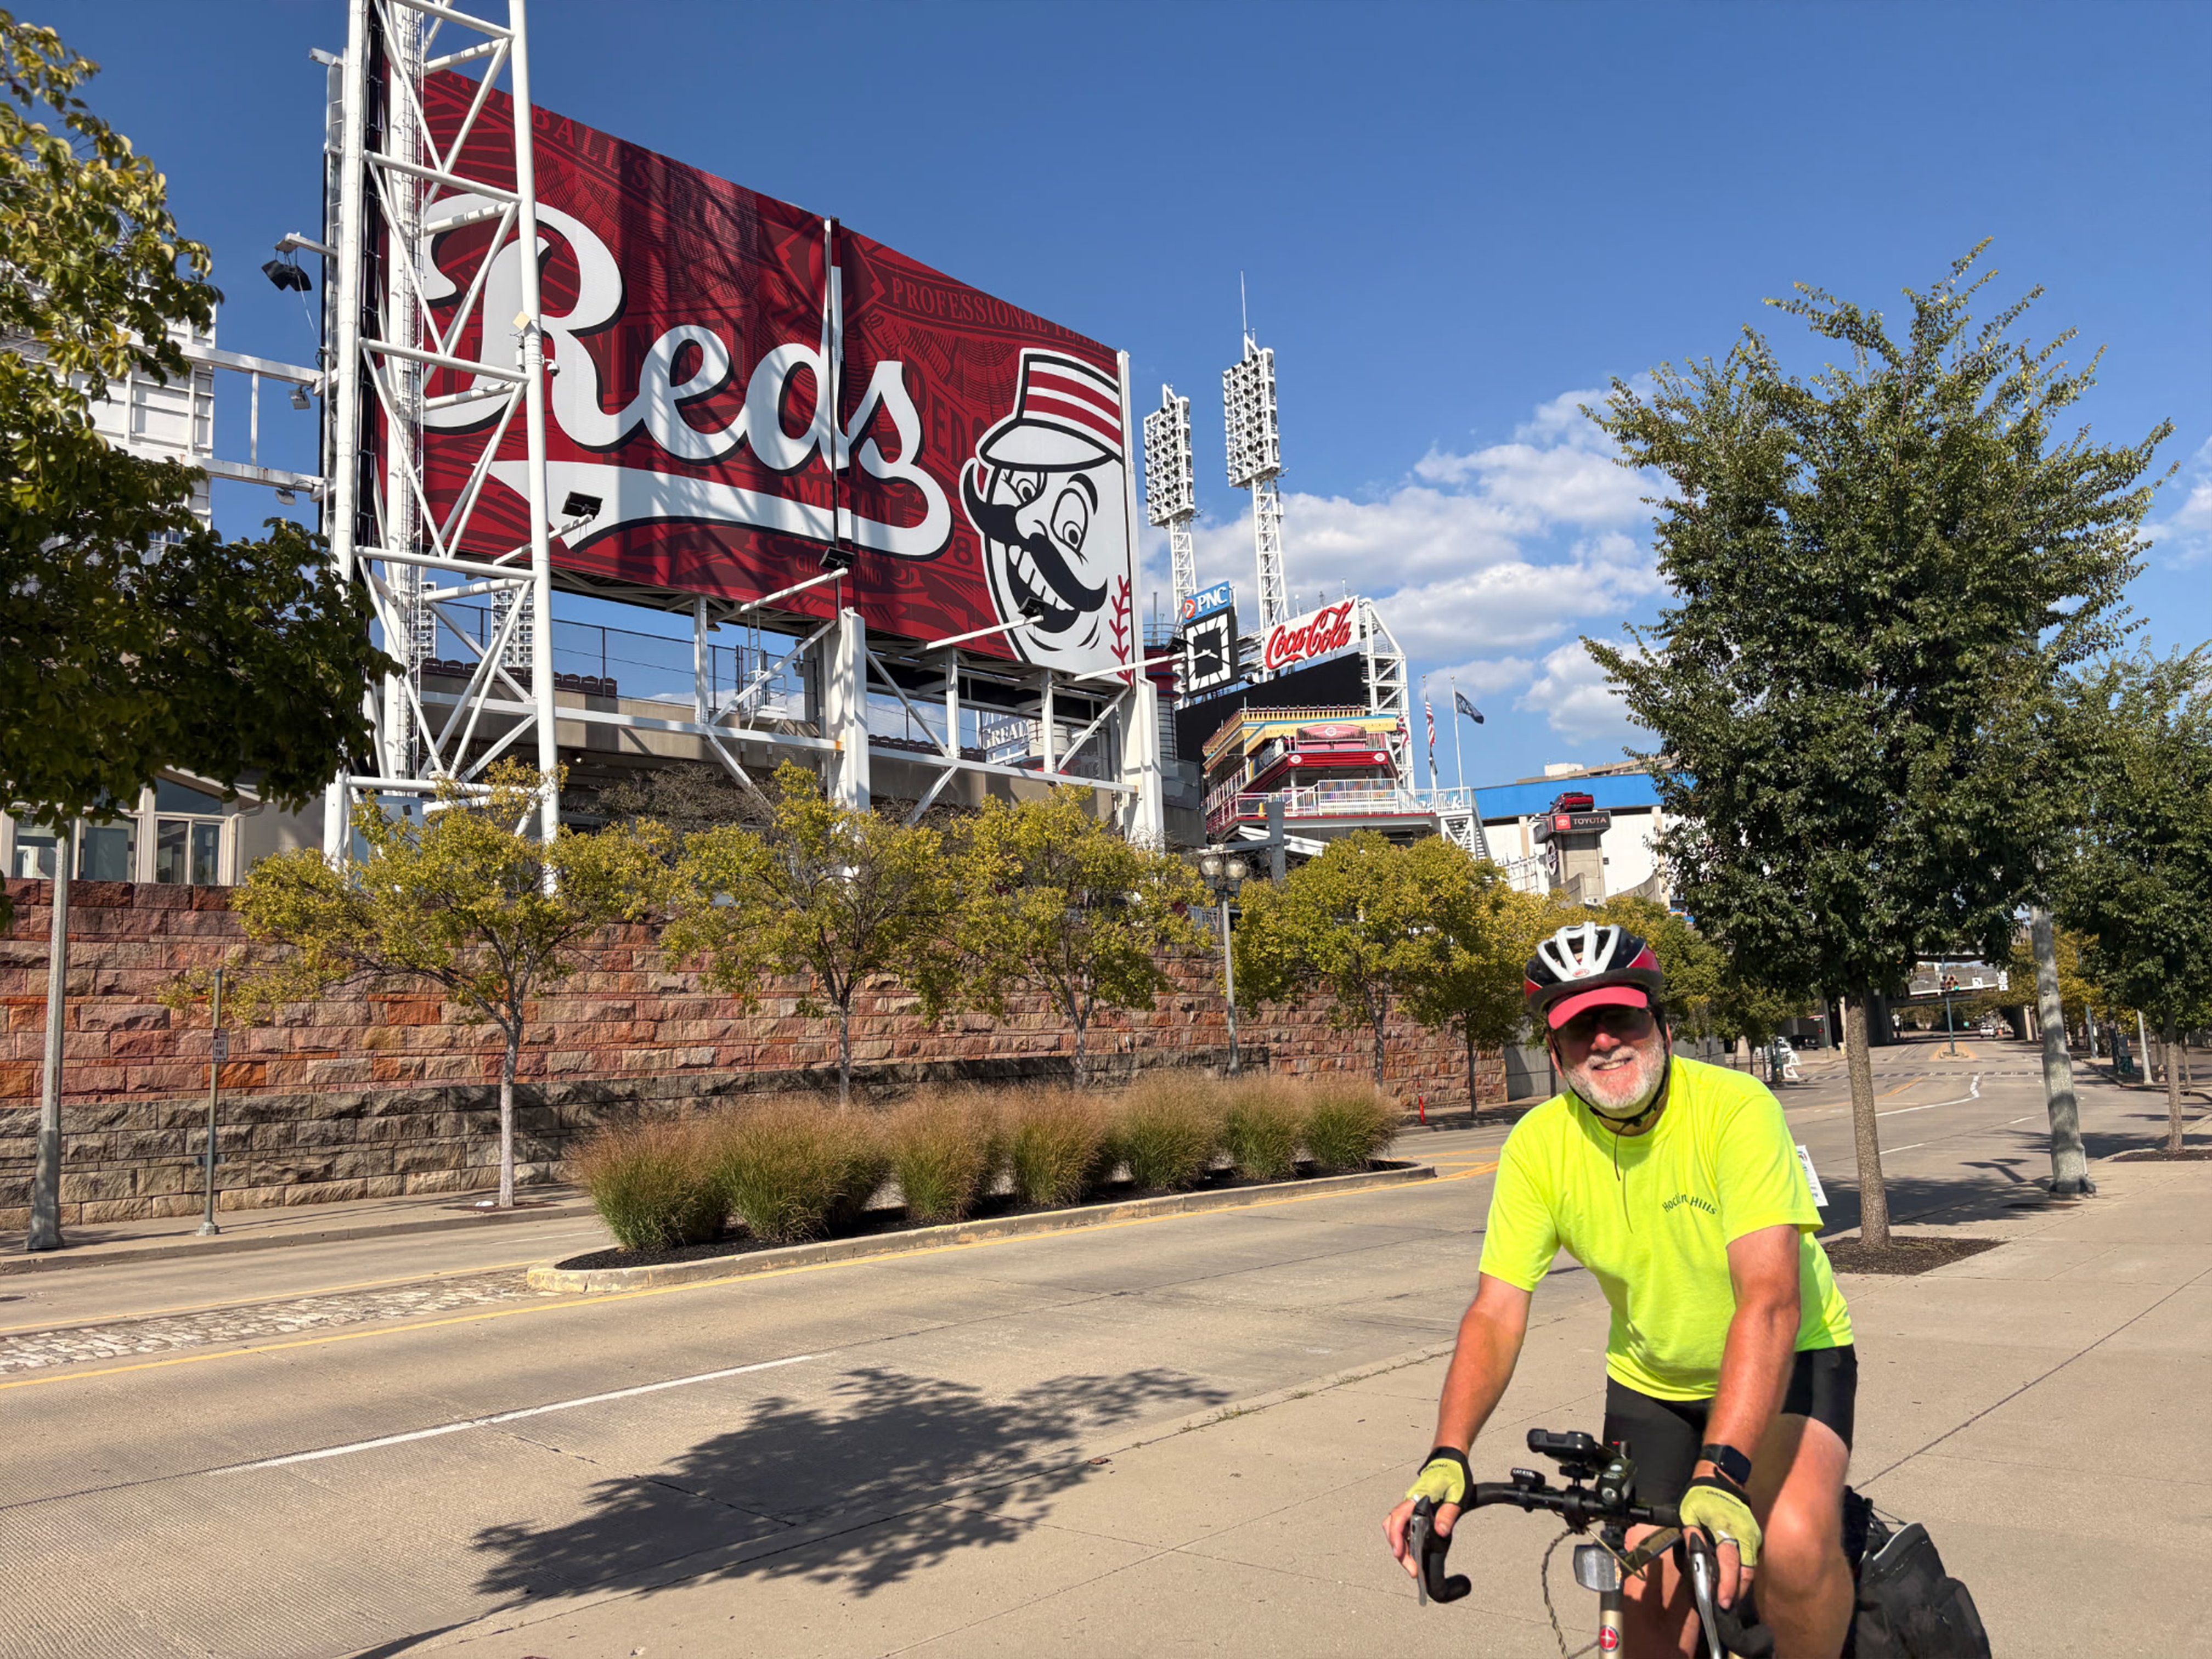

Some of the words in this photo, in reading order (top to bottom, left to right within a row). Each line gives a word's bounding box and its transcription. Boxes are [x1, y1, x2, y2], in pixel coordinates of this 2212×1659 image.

[891, 276, 1048, 334] PROFESSIONAL
[379, 193, 952, 554] Reds
[1196, 586, 1227, 613] PNC
[1265, 599, 1356, 670] Coca-Cola
[1573, 816, 1607, 825] TOYOTA
[1662, 1192, 1688, 1213] Hocin
[1690, 1196, 1717, 1215] Hills
